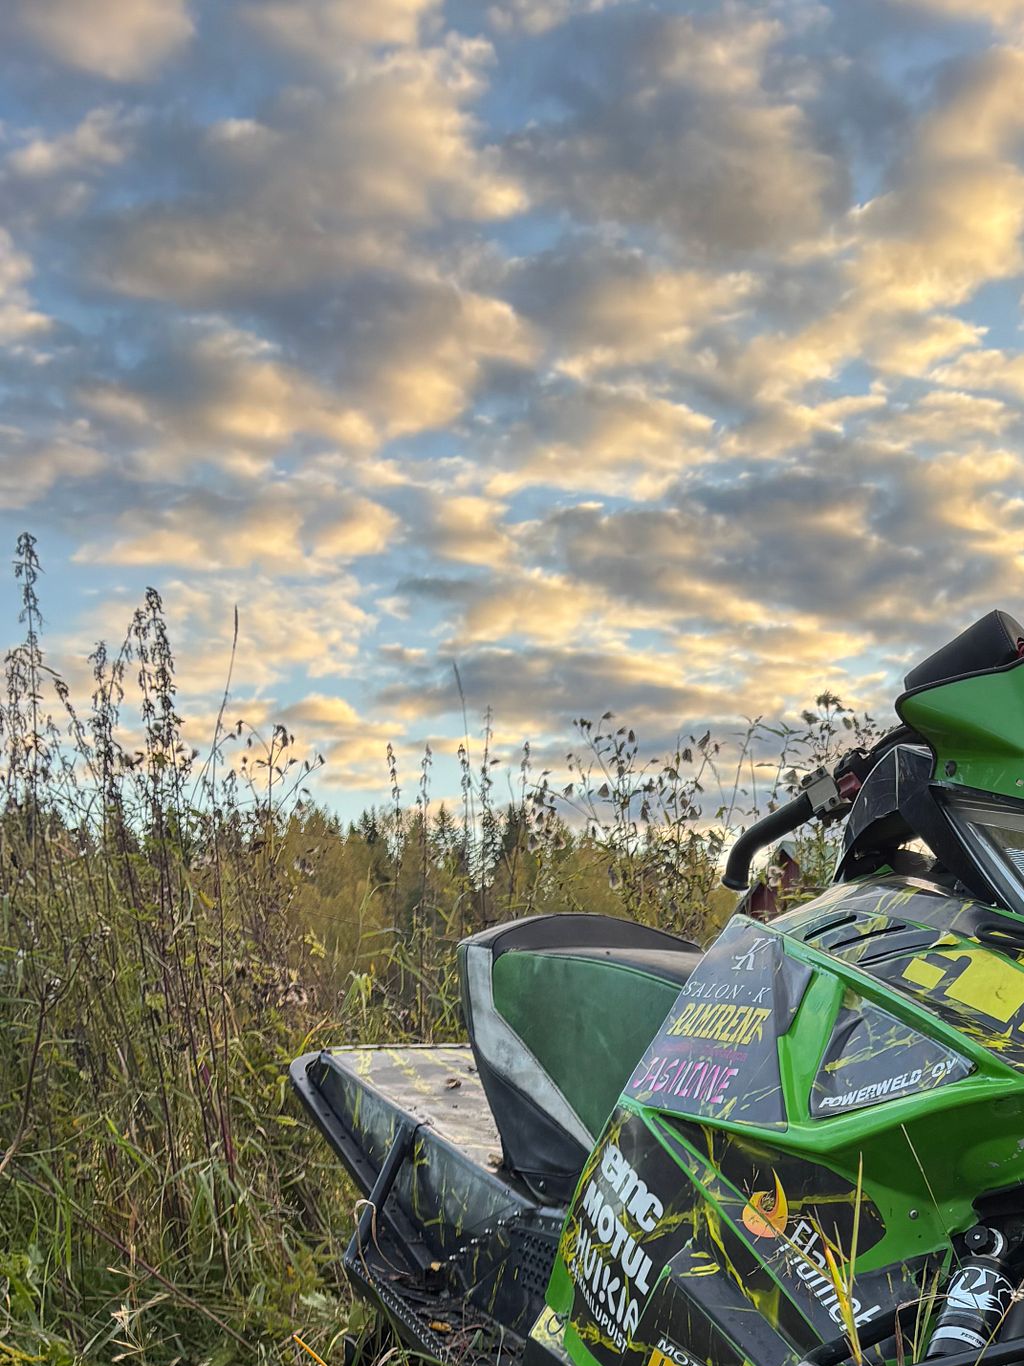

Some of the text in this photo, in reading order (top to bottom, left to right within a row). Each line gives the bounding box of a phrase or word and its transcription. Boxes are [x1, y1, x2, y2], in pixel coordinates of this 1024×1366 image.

[683, 981, 772, 1003] SALON K
[666, 1003, 772, 1045] RAMIRENT
[818, 1068, 922, 1109] POWERWELD
[582, 1179, 650, 1296] MOTUL
